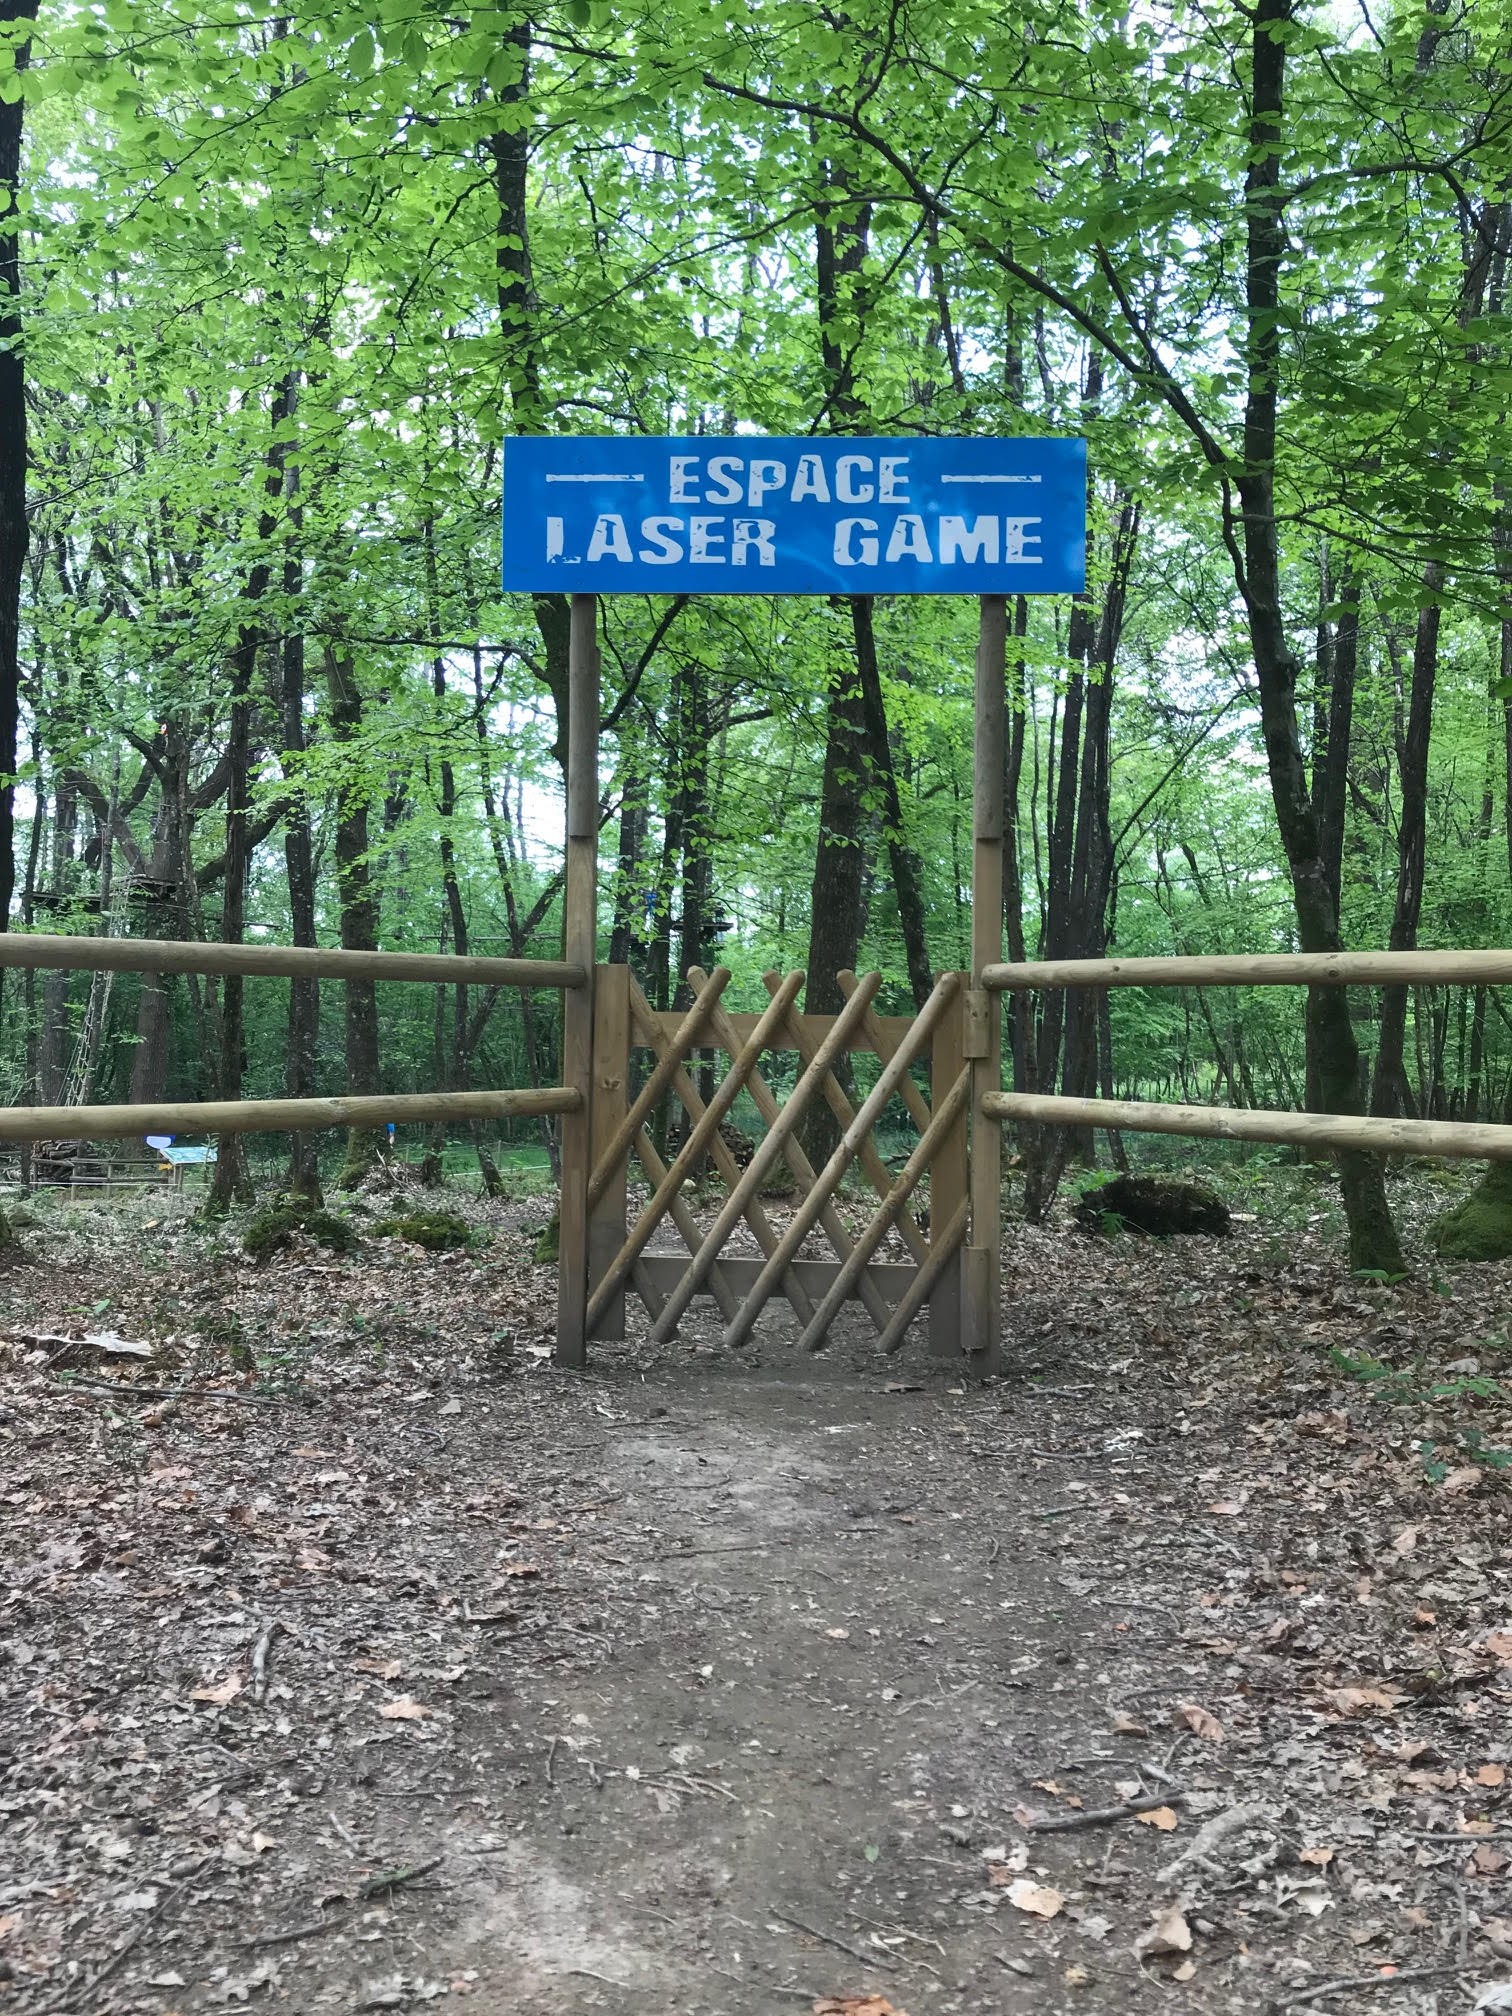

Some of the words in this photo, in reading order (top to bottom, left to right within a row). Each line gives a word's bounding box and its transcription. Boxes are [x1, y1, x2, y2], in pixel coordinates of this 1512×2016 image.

[669, 455, 910, 507] ESPACE
[546, 514, 776, 566] LASER
[833, 514, 1043, 566] GAME
